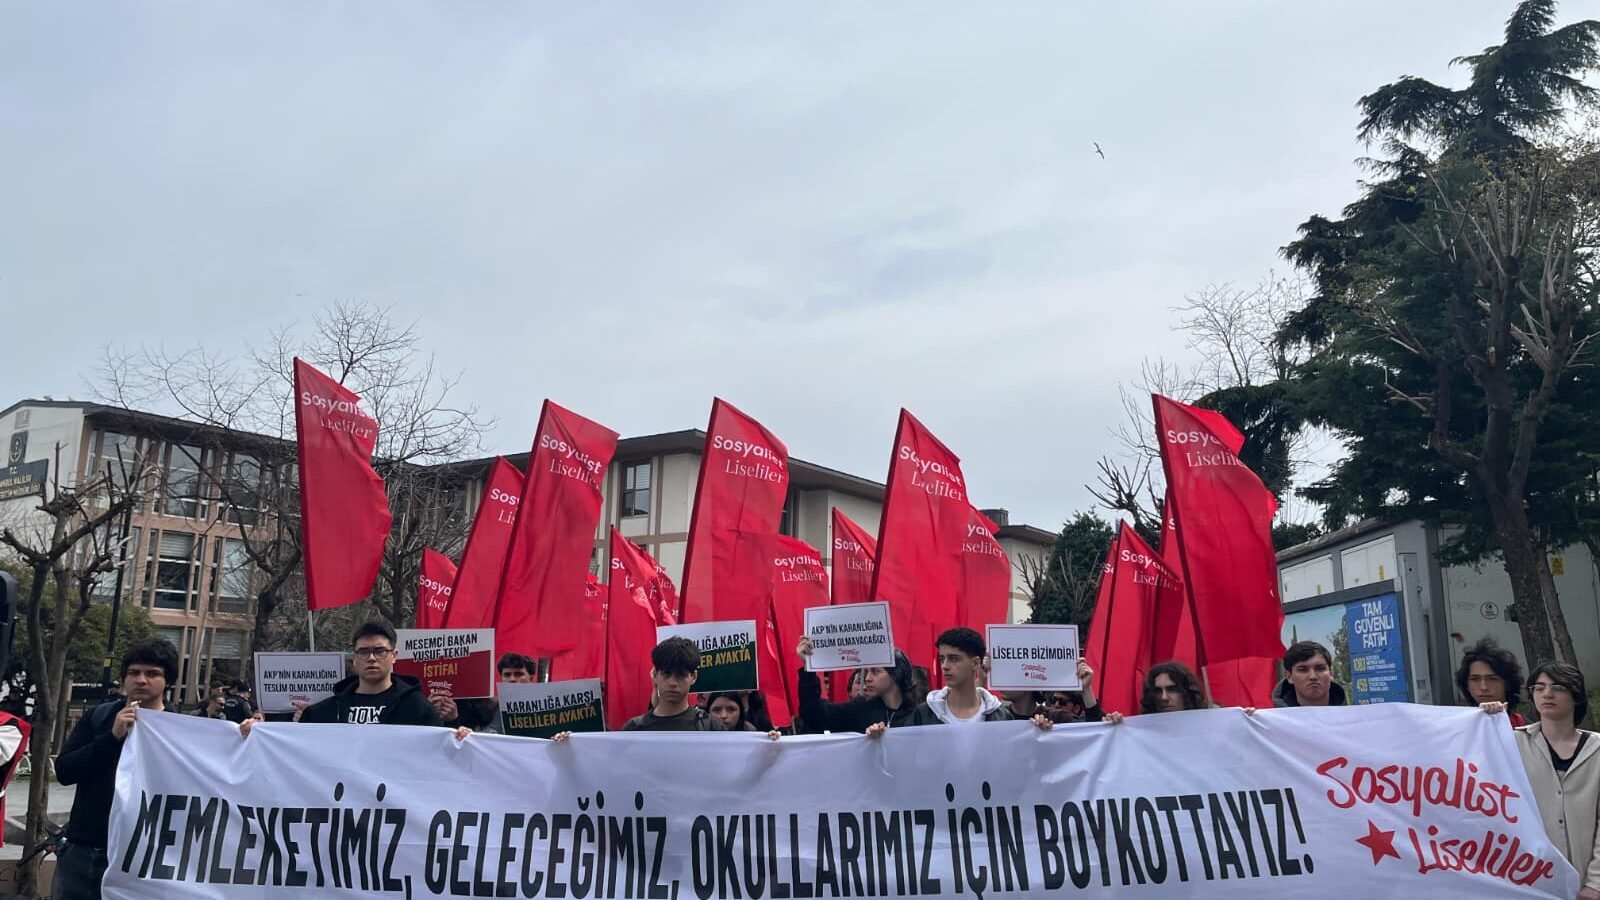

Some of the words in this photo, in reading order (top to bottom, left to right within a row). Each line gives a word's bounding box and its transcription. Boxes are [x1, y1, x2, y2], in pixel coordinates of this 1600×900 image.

[713, 435, 785, 470] Sosyalist
[726, 459, 784, 483] Liseliler
[1361, 600, 1383, 618] TAM
[405, 634, 445, 650] MESEMCİ
[447, 633, 478, 647] BAKAN
[719, 632, 749, 648] KARŞI
[413, 648, 441, 661] YUSUF
[715, 649, 751, 666] AYAKTA
[992, 646, 1029, 660] LİSELER
[1031, 645, 1075, 660] BİZİMDİR!
[423, 662, 458, 678] İSTİFA!
[264, 683, 287, 692] TESLİM
[506, 695, 561, 713] KARANLIĞA
[563, 690, 594, 706] KARŞI
[509, 712, 557, 729] LİSELİLER
[559, 706, 597, 724] AYAKTA
[1316, 757, 1520, 823] Sosyalist
[424, 790, 679, 900] GELECEĞİMİZ,
[692, 811, 941, 900] OKULLARIMIZ
[945, 781, 1029, 900] İÇİN
[1034, 788, 1314, 890] BOYKOTTAYIZ!
[1408, 825, 1553, 886] Liseliler
